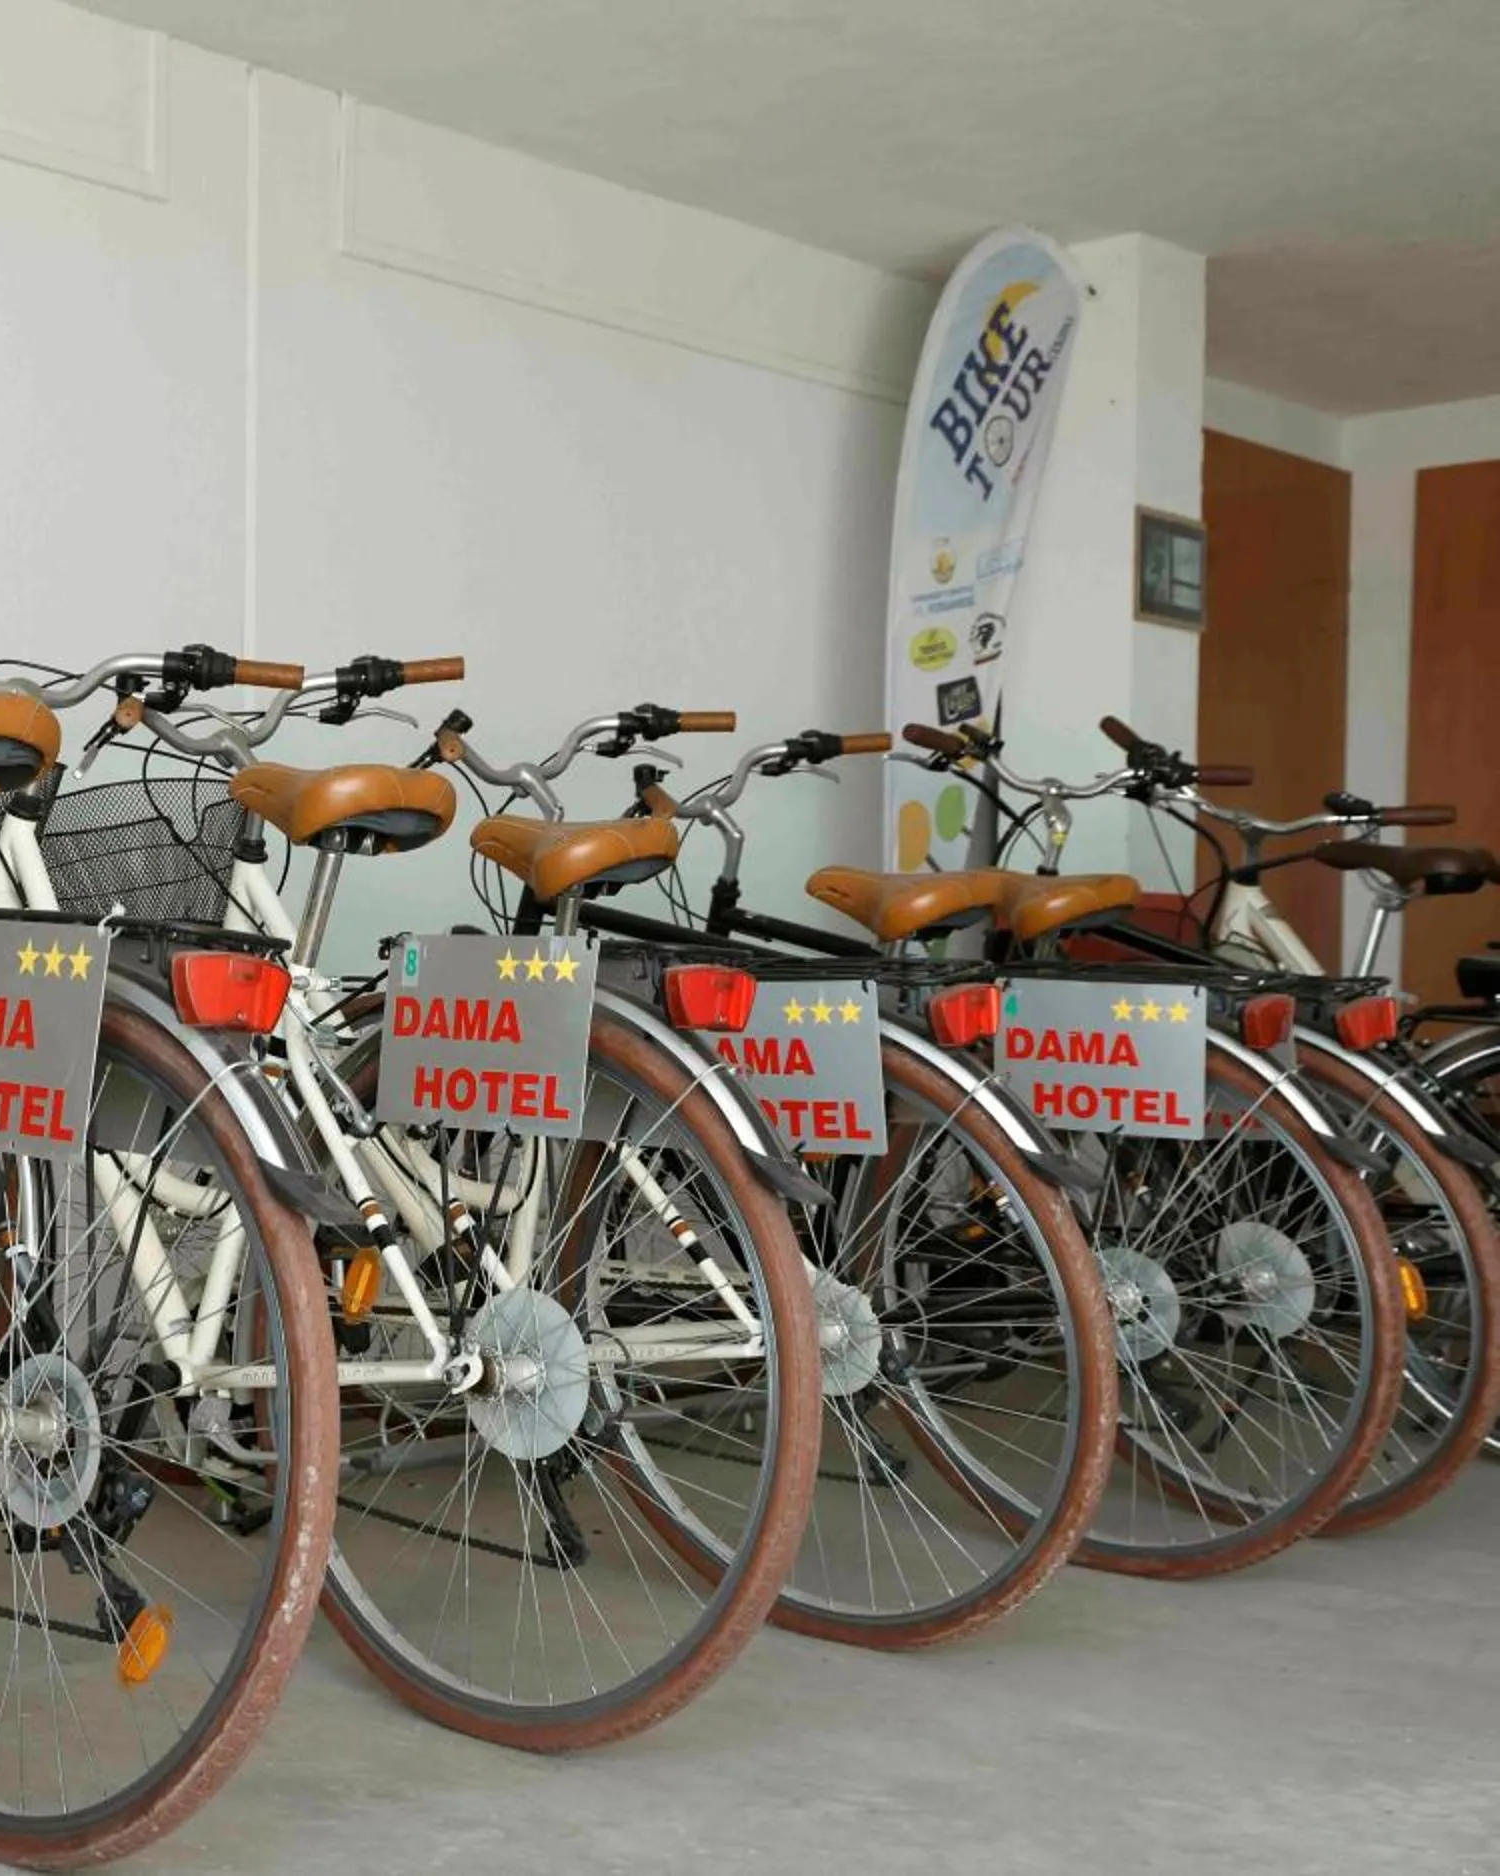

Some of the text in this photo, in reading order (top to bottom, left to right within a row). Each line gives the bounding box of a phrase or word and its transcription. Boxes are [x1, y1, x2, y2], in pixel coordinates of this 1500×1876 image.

[929, 301, 1029, 464] BIKE
[404, 947, 418, 977] 8
[392, 996, 523, 1045] DAMA
[716, 1036, 816, 1077] AMA
[1005, 1026, 1141, 1068] DAMA
[412, 1066, 571, 1120] HOTEL
[1032, 1082, 1191, 1127] HOTEL
